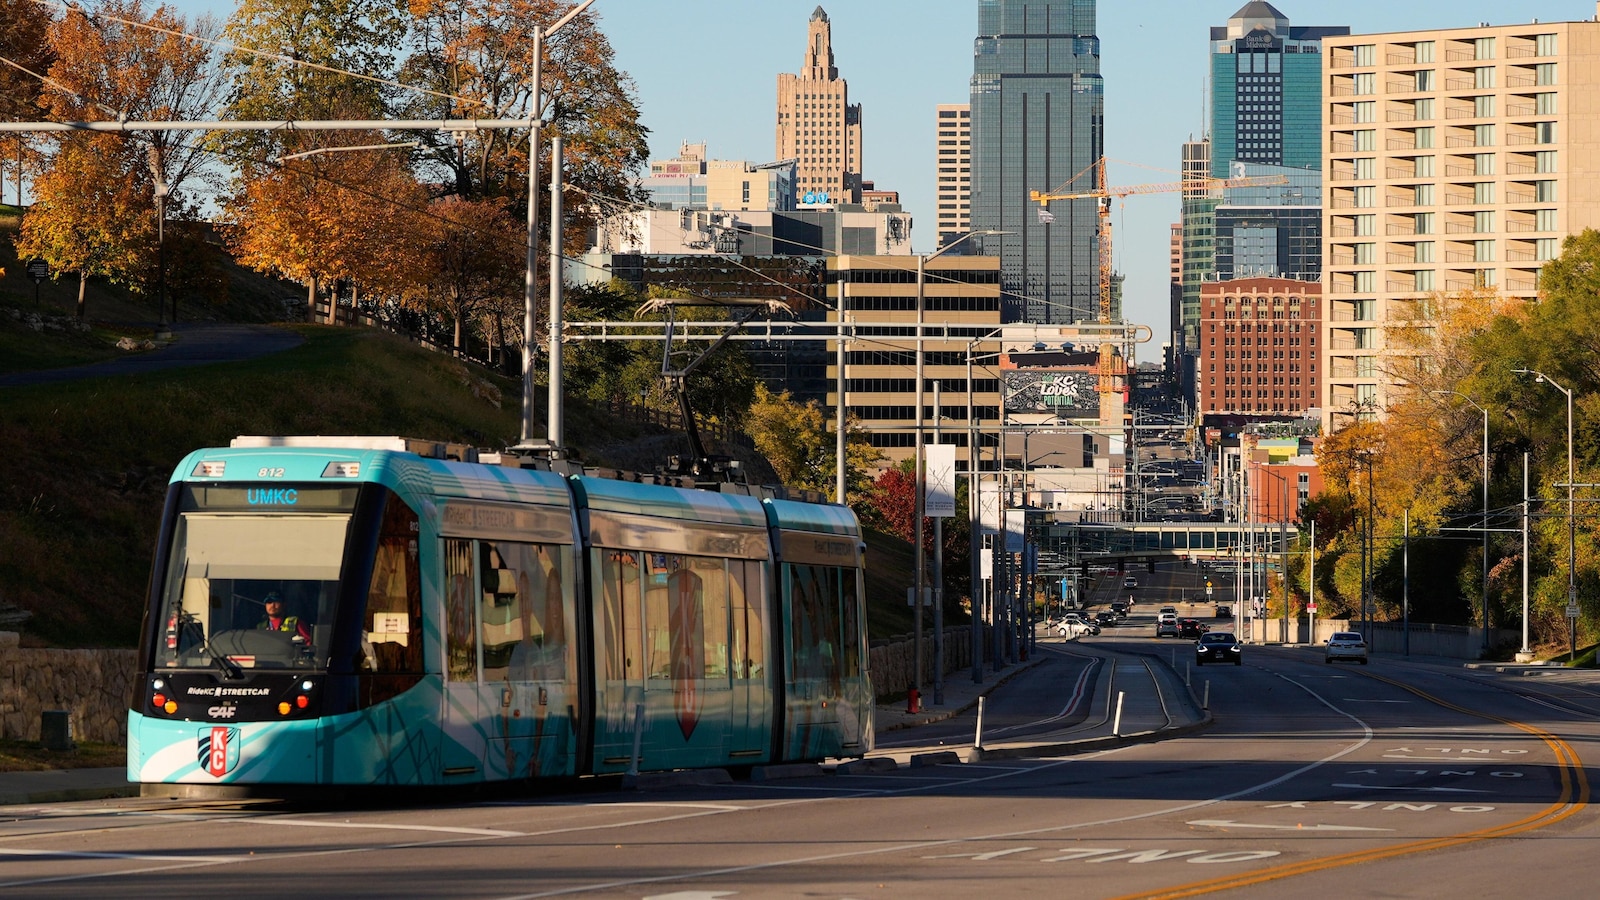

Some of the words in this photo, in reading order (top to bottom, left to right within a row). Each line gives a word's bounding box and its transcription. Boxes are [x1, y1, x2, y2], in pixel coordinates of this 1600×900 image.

[1233, 162, 1246, 179] 3
[1053, 375, 1074, 388] KC
[257, 467, 285, 478] 812
[247, 488, 298, 505] UMKC
[409, 521, 419, 532] 812
[187, 687, 215, 695] RideKC
[222, 688, 270, 696] STREETCAR
[208, 706, 236, 718] CAF
[212, 730, 224, 770] KC
[1384, 746, 1529, 755] ONLY
[1345, 768, 1525, 778] ONLY
[1263, 800, 1497, 813] ONLY
[920, 846, 1282, 864] ONLY
